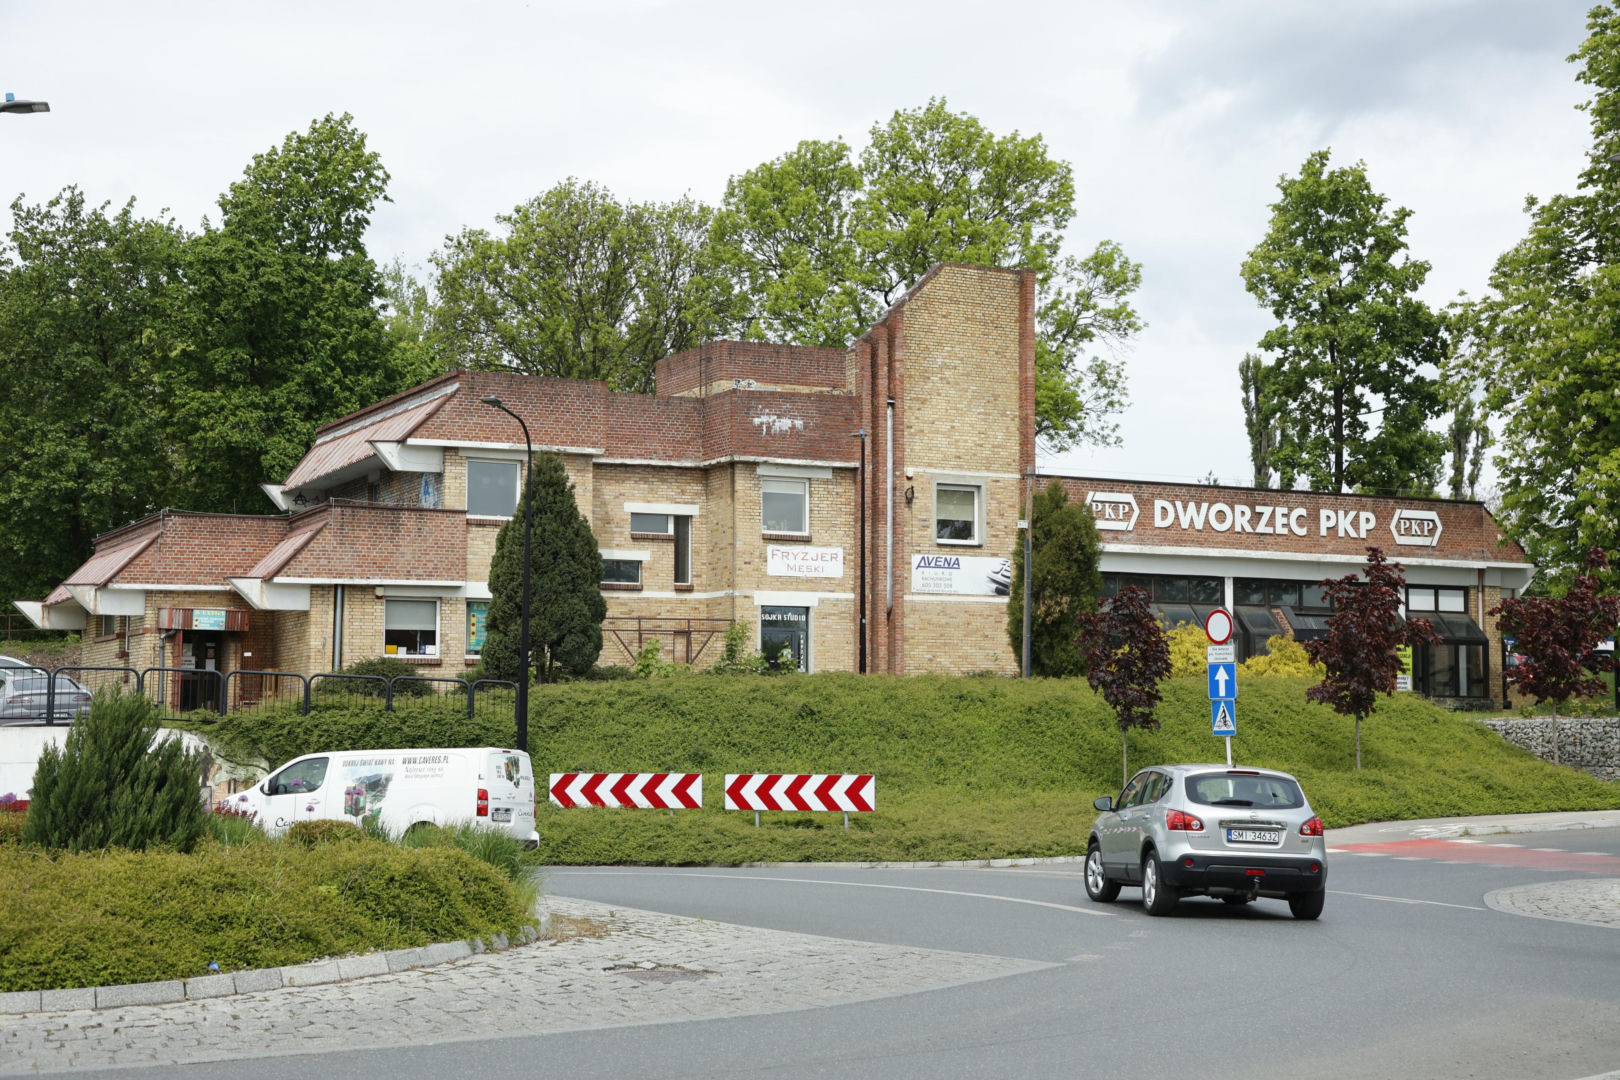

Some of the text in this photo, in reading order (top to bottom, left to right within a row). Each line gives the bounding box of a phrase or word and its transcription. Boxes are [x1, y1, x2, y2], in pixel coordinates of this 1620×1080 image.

[1092, 502, 1129, 520] PKP
[1154, 499, 1376, 539] DWORZEC PKP
[1400, 519, 1434, 536] PKP
[771, 549, 839, 562] FRYZJER
[915, 556, 961, 570] AVENA
[783, 614, 806, 622] STUDIO
[1233, 831, 1278, 842] SMI 34632
